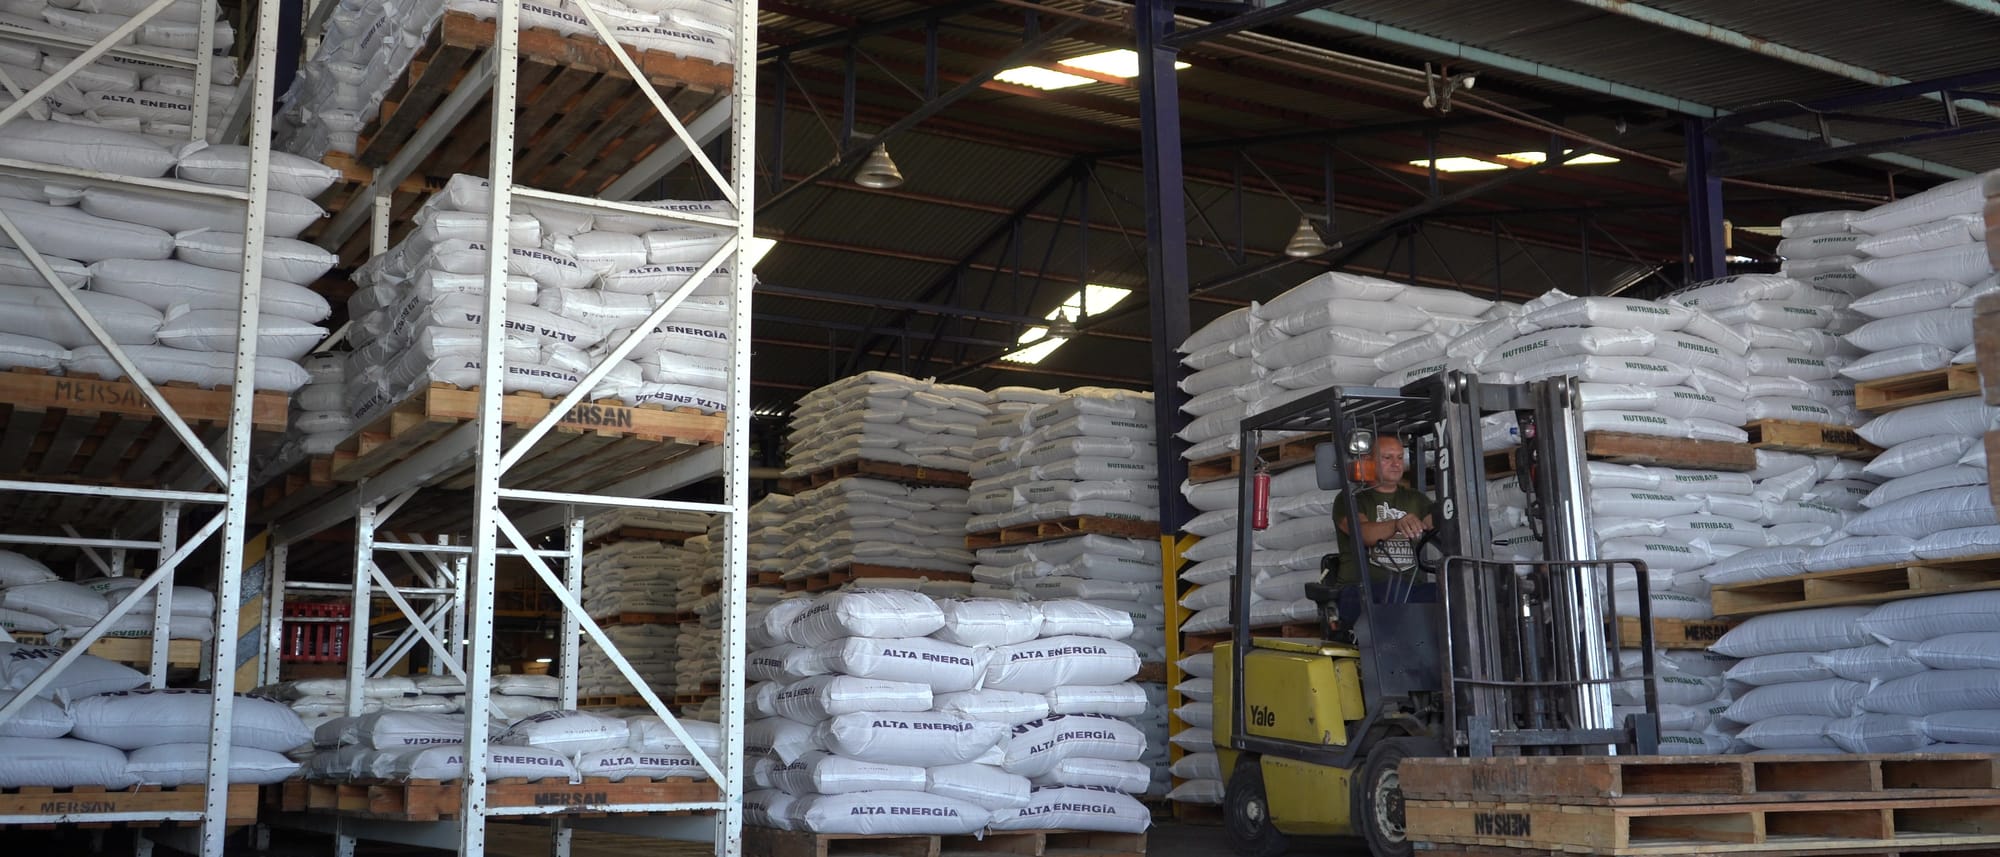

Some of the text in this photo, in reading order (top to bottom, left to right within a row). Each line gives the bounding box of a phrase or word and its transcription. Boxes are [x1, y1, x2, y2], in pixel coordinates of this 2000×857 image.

[521, 3, 588, 26] ENERGÍA
[616, 25, 715, 45] ALTA ENERGÍA
[101, 94, 192, 111] ALTA ENERGÍ
[654, 203, 712, 211] NERGÍA
[511, 248, 578, 268] ENERGÍA
[629, 266, 662, 274] ALTA
[1626, 305, 1671, 315] NUTRIBASE
[540, 328, 577, 343] ALTA
[666, 325, 728, 340] ENERGÍA
[1502, 339, 1550, 360] NUTRIBASE
[1678, 341, 1720, 355] NUTRIBASE
[1625, 362, 1669, 372] NUTRIBASE
[1787, 357, 1825, 367] NUTRIBASE
[509, 366, 578, 383] ENERGÍA
[1673, 391, 1717, 403] NUTRIBASE
[1791, 405, 1829, 414] NUTRIBASE
[1623, 414, 1667, 425] NUTRIBASE
[1434, 418, 1454, 520] Yale
[1675, 474, 1719, 482] NUTRIBASE
[1631, 493, 1676, 501] NUTRIBASE
[1690, 521, 1734, 530] NUTRIBASE
[1645, 544, 1691, 553] NUTRIBASE
[1651, 593, 1698, 602] NUTRIBASE
[883, 648, 974, 667] ALTA ENERGÍ
[1011, 645, 1107, 662] ALTA ENERGÍA
[1250, 705, 1276, 728] Yale
[872, 720, 974, 732] ALTA ENERGÍA
[1030, 730, 1116, 755] ALTA ENERGÍA
[1661, 736, 1705, 745] NUTRIBASE
[493, 755, 565, 768] ENERGÍA
[600, 757, 634, 767] ALTA
[534, 792, 608, 806] MERSAN
[40, 802, 116, 814] MERSAN
[851, 806, 958, 817] ALTA ENERGÍA
[1019, 802, 1116, 817] ALTA ENERGÍA
[1475, 812, 1531, 836] MERSAN
